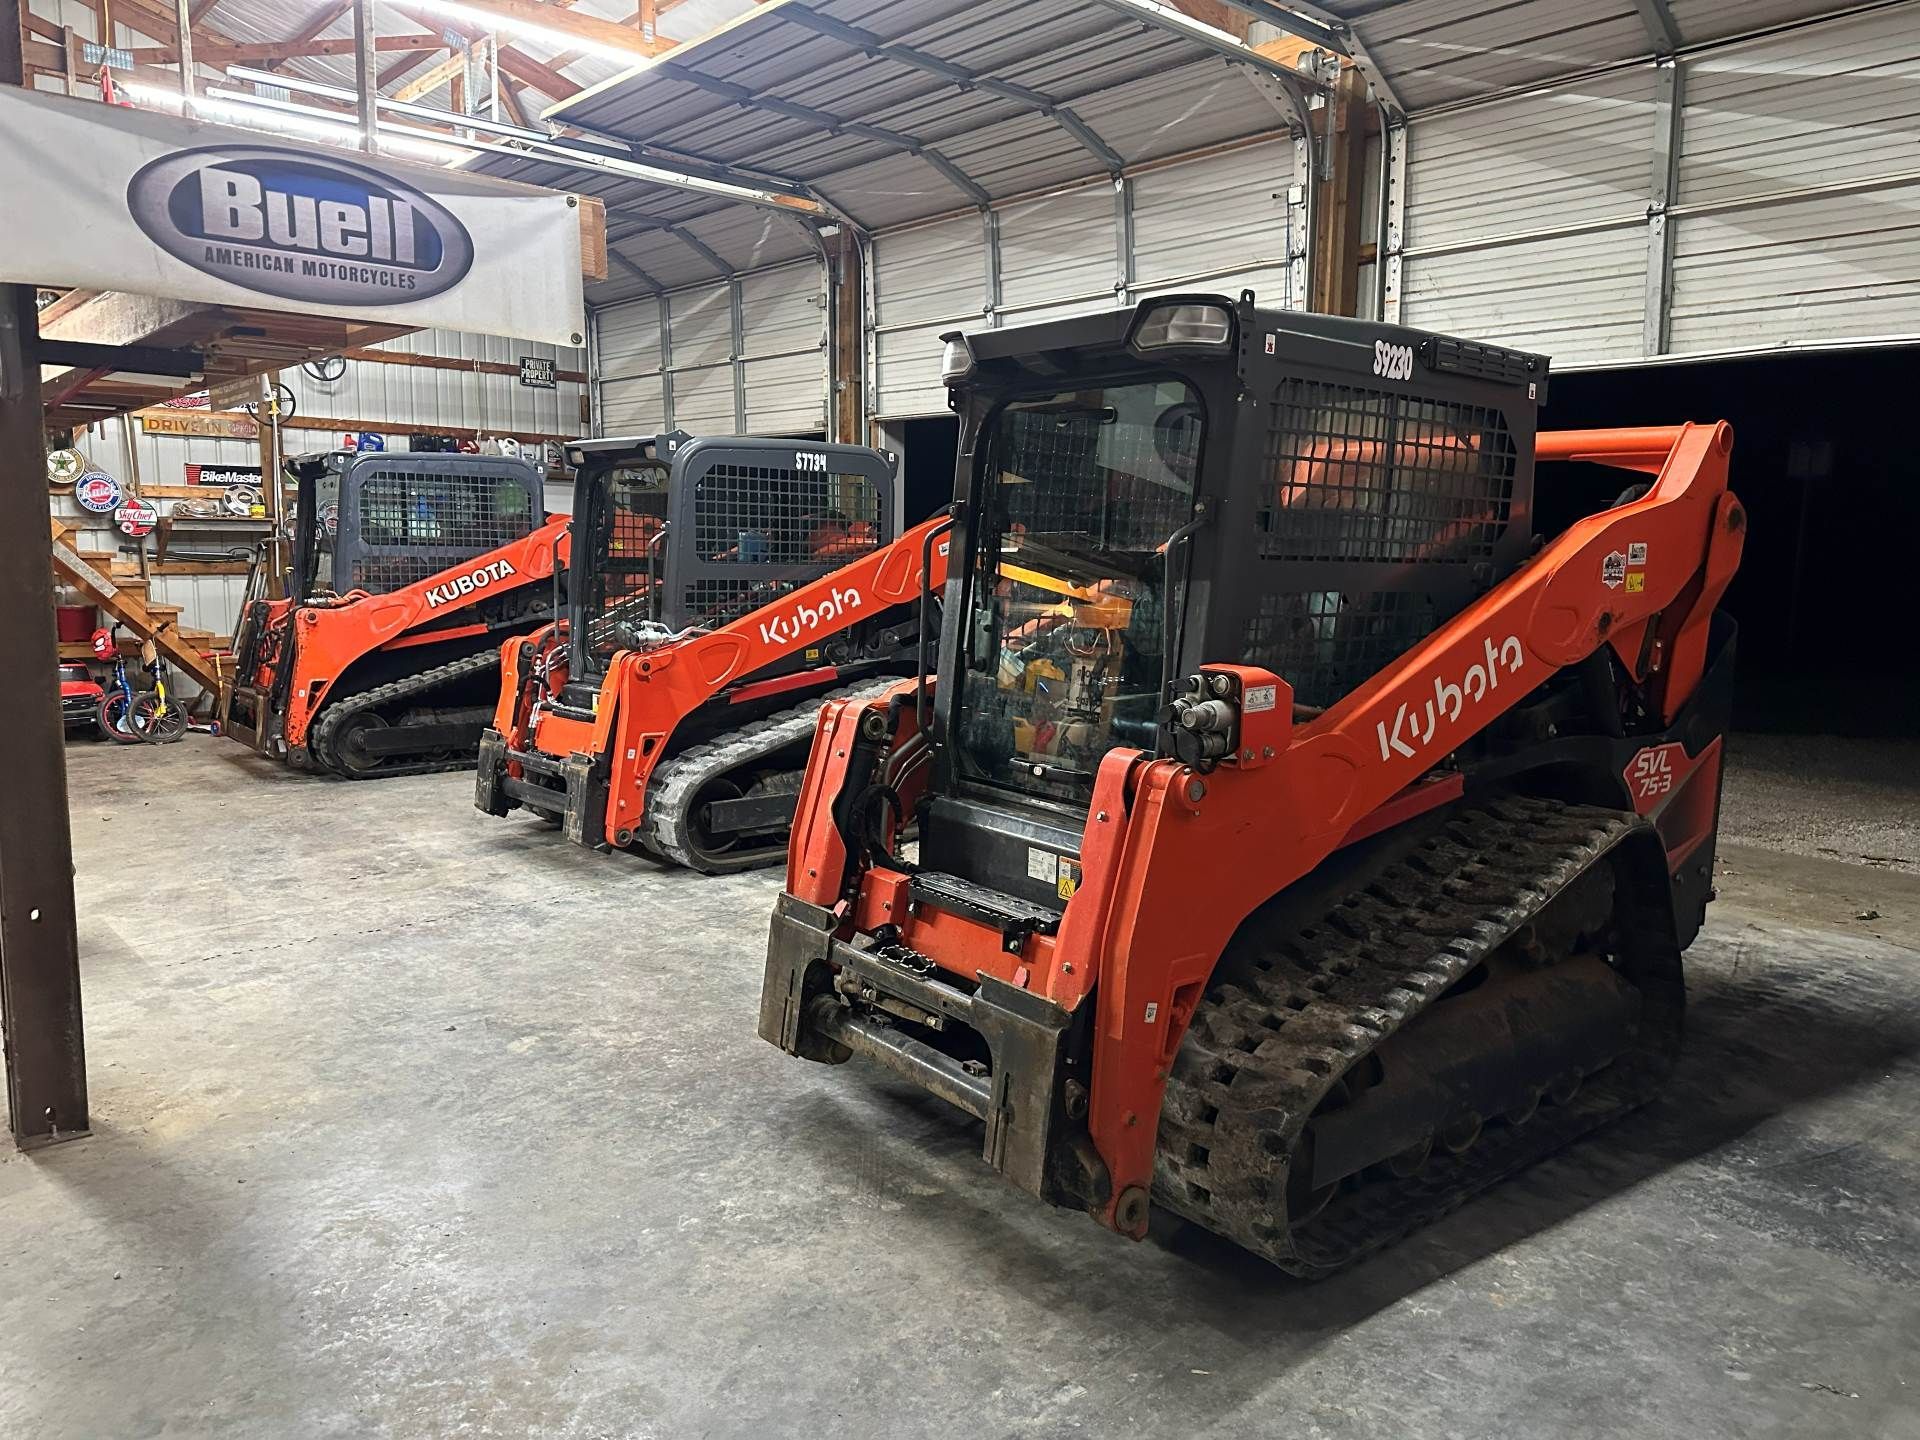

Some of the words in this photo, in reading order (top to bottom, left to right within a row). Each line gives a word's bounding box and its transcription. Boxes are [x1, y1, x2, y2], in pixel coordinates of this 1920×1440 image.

[200, 167, 415, 264] Buell
[204, 246, 294, 273] AMERICAN
[302, 263, 416, 289] MOTORCYCLES
[521, 368, 554, 380] PROPERTY
[525, 359, 550, 371] PRIVATE
[1373, 339, 1413, 381] S9230
[148, 418, 201, 433] DRIVE
[206, 421, 222, 433] IN
[795, 451, 827, 472] S7734
[200, 471, 262, 483] BikeMaster
[118, 509, 133, 521] Sky
[133, 510, 154, 521] Chief
[425, 559, 517, 608] KUBOTA
[760, 587, 862, 645] Kubota
[1376, 635, 1524, 762] Kubota
[1634, 750, 1672, 778] SVL
